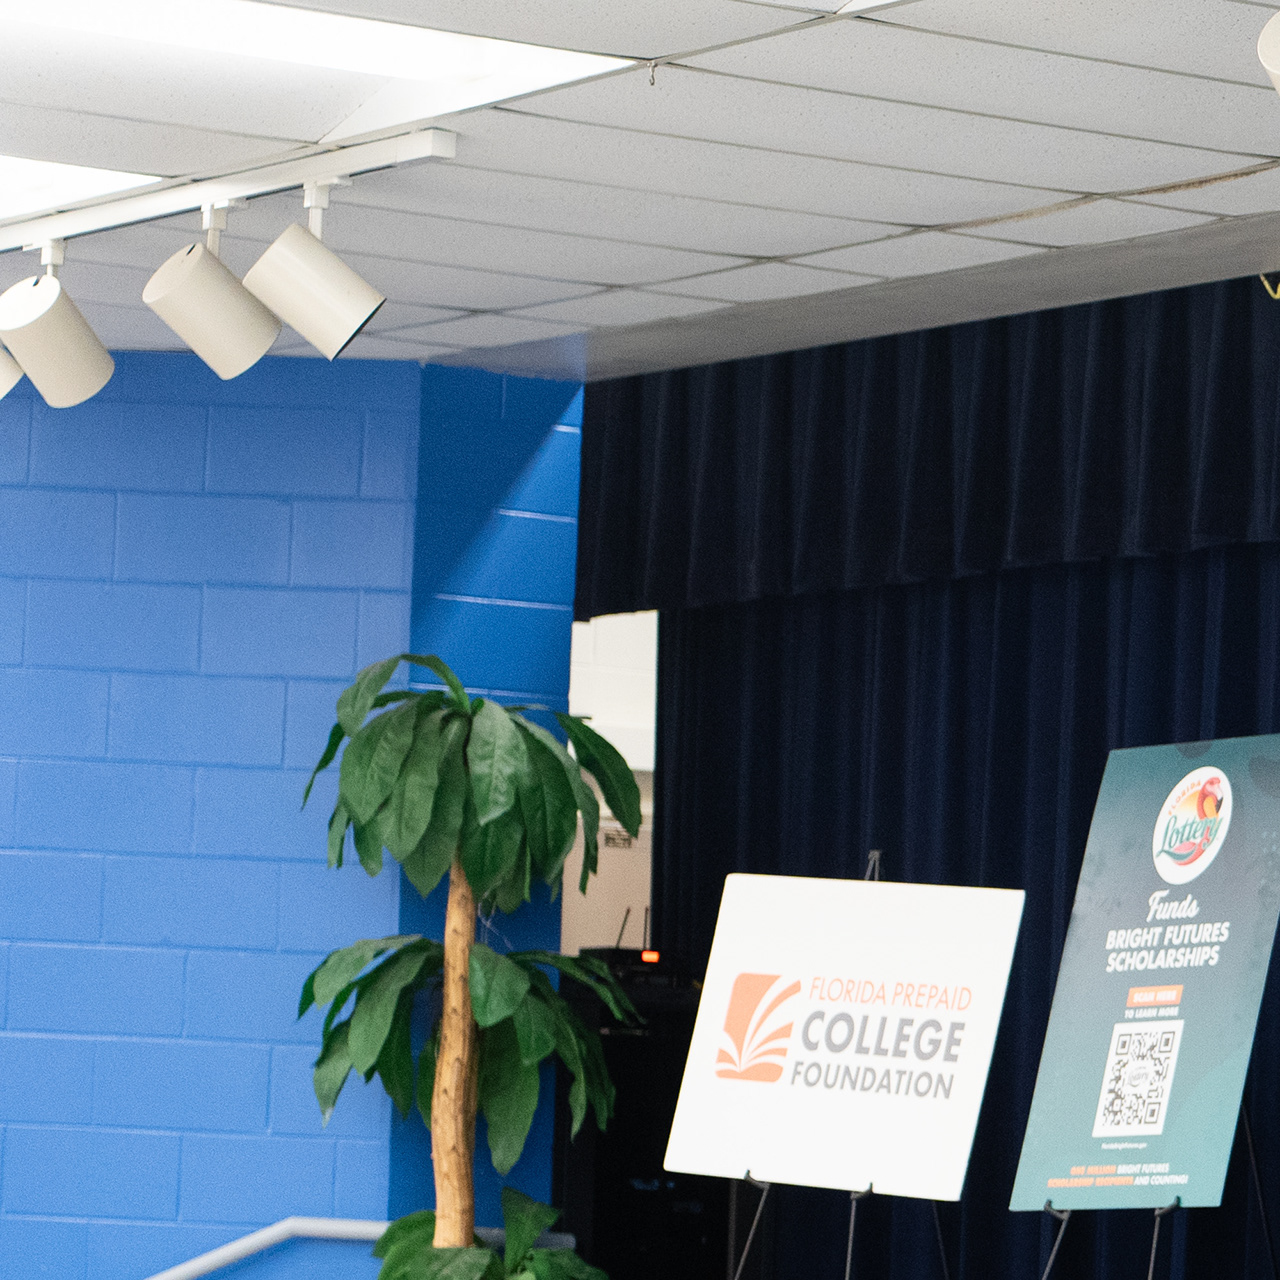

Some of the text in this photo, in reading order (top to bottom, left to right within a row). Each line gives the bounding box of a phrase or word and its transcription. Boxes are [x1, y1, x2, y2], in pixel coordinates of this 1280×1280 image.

[1155, 815, 1224, 859] Lottery
[1146, 889, 1199, 922] Funds
[1105, 921, 1230, 950] BRIGHT FUTURES
[1106, 945, 1220, 973] SCHOLARSHIPS
[808, 976, 972, 1012] FLORIDA PREPAID
[802, 1010, 965, 1062] COLLEGE
[790, 1061, 954, 1099] FOUNDATION
[1117, 1164, 1142, 1174] BRIGHT
[1142, 1162, 1170, 1174] FUTURES
[1133, 1175, 1150, 1186] AND
